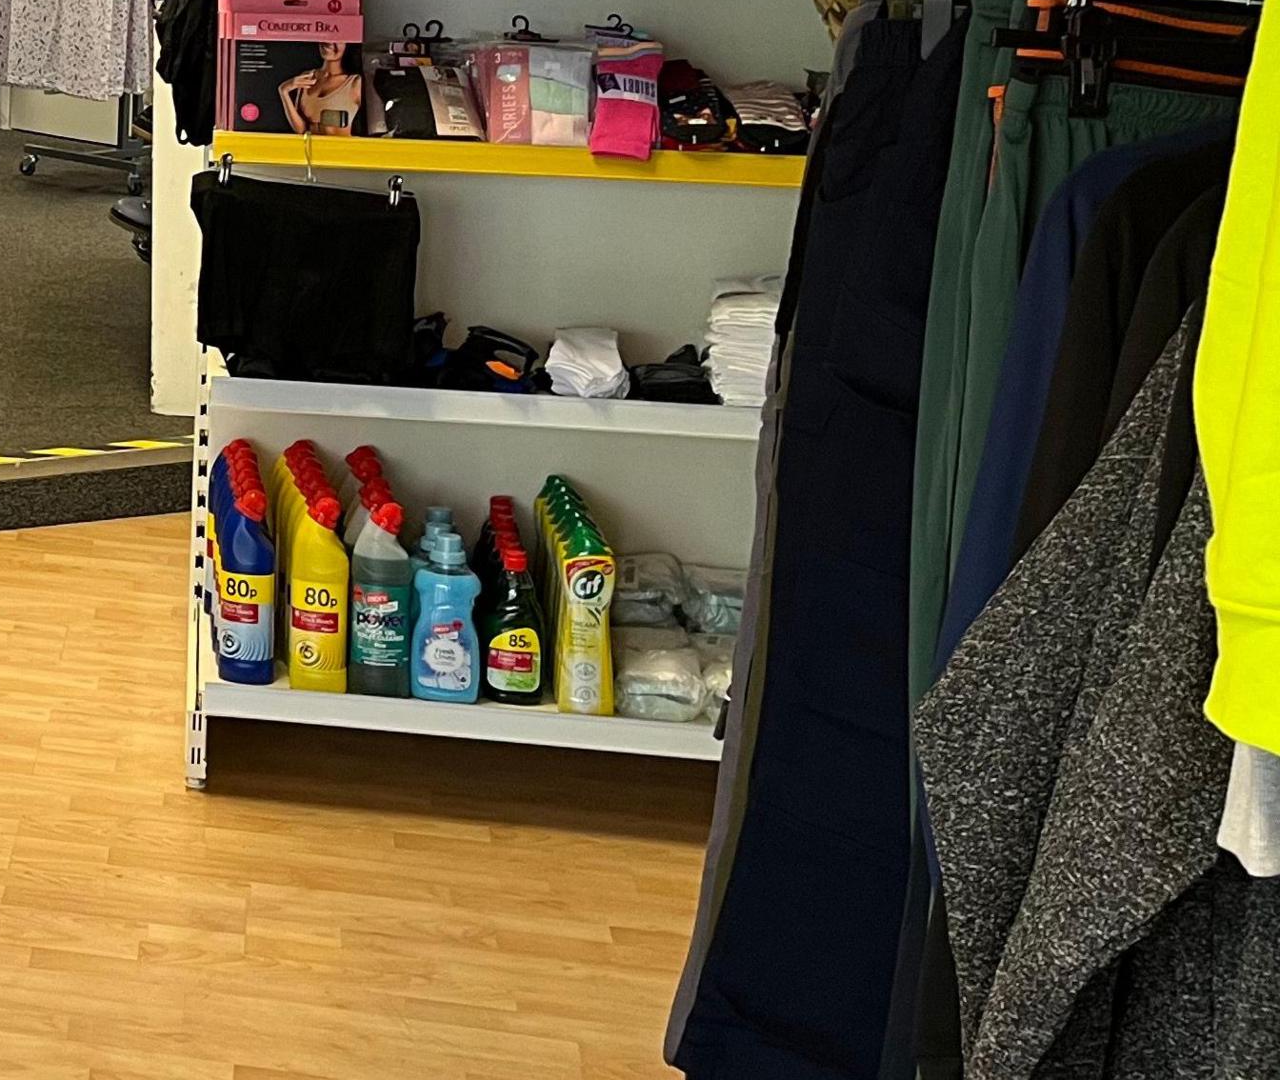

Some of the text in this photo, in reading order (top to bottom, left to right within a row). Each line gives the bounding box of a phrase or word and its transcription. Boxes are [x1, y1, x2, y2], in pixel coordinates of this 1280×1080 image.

[315, 21, 340, 33] BRA
[494, 52, 501, 64] 3
[623, 77, 656, 98] LADIES
[501, 83, 517, 129] BRIEFS
[226, 577, 258, 599] 80p
[574, 574, 602, 598] Cif
[304, 587, 338, 608] 80p
